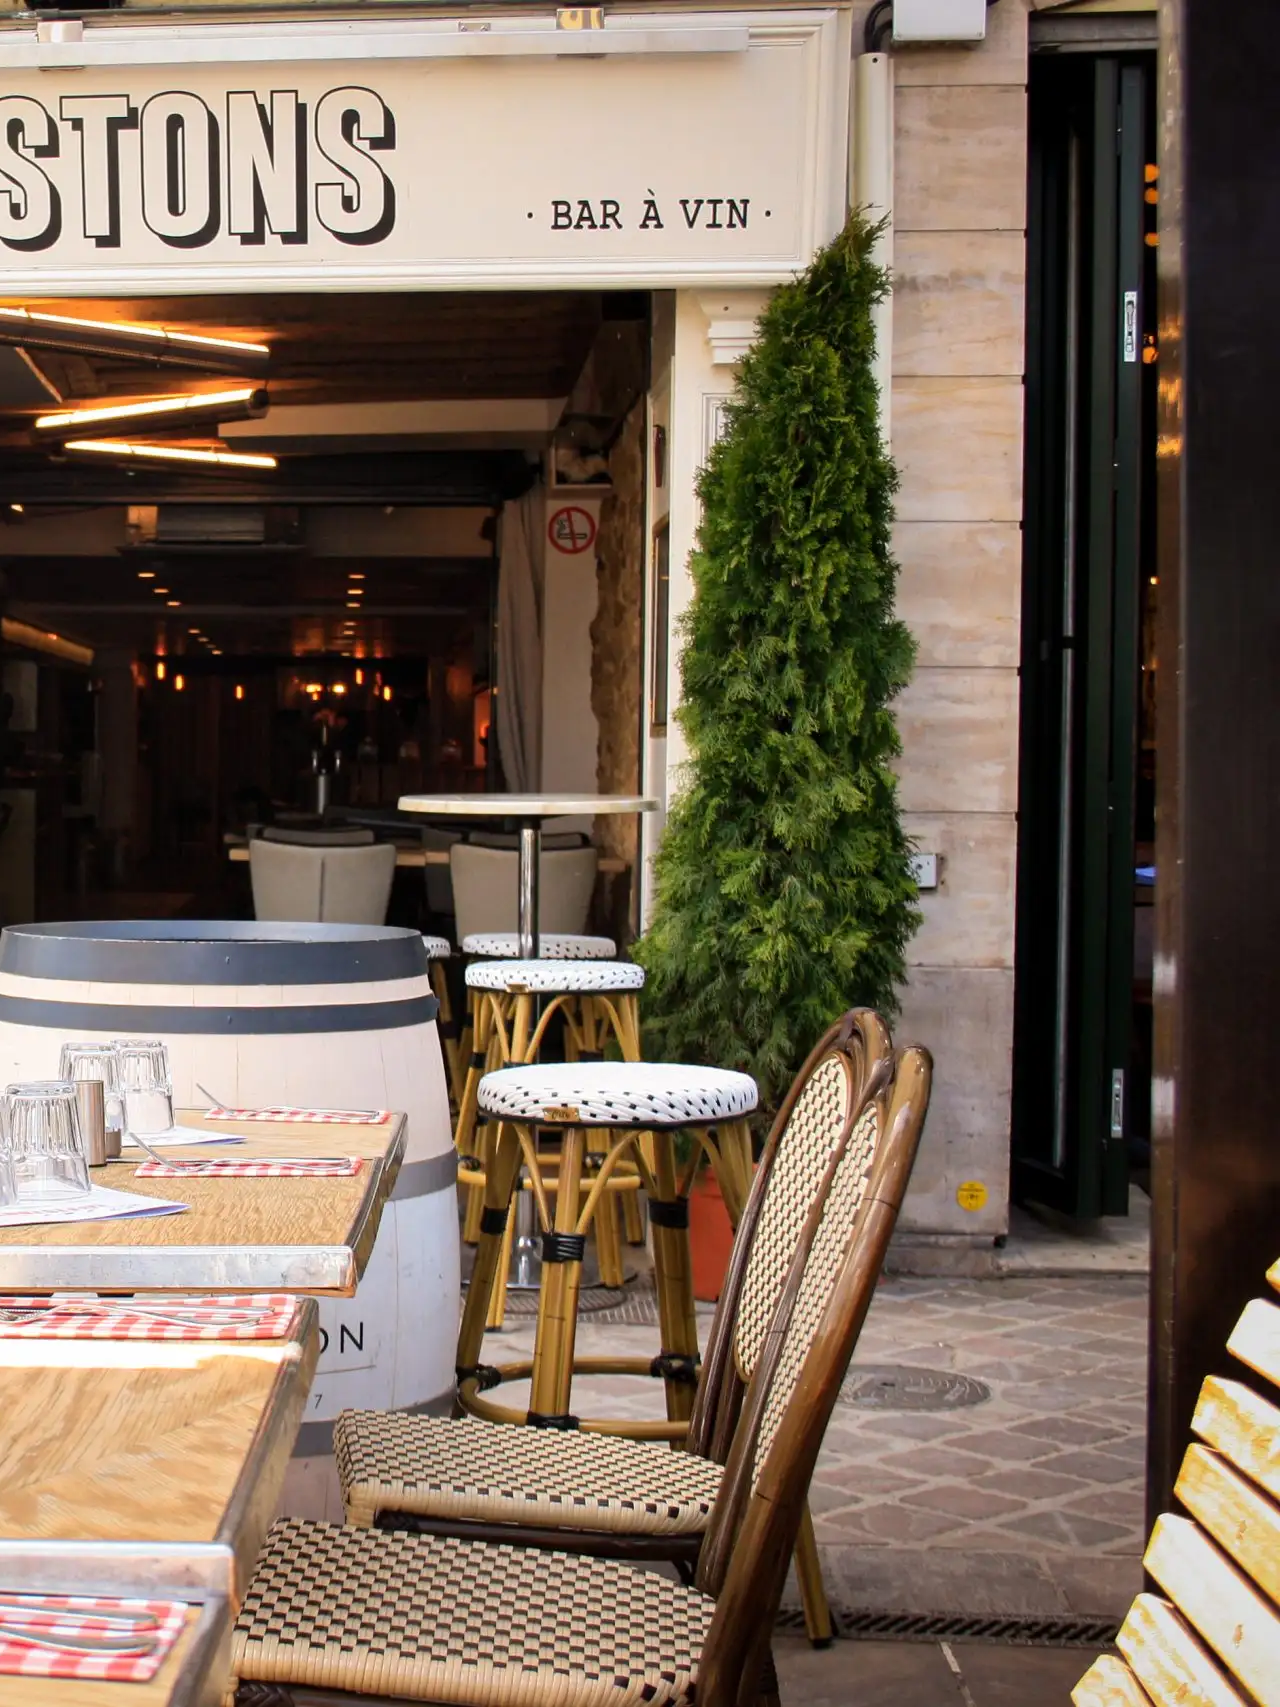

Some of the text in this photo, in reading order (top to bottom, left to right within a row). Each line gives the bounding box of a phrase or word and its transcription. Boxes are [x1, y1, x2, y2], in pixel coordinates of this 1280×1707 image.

[551, 188, 750, 230] BAR À VIN
